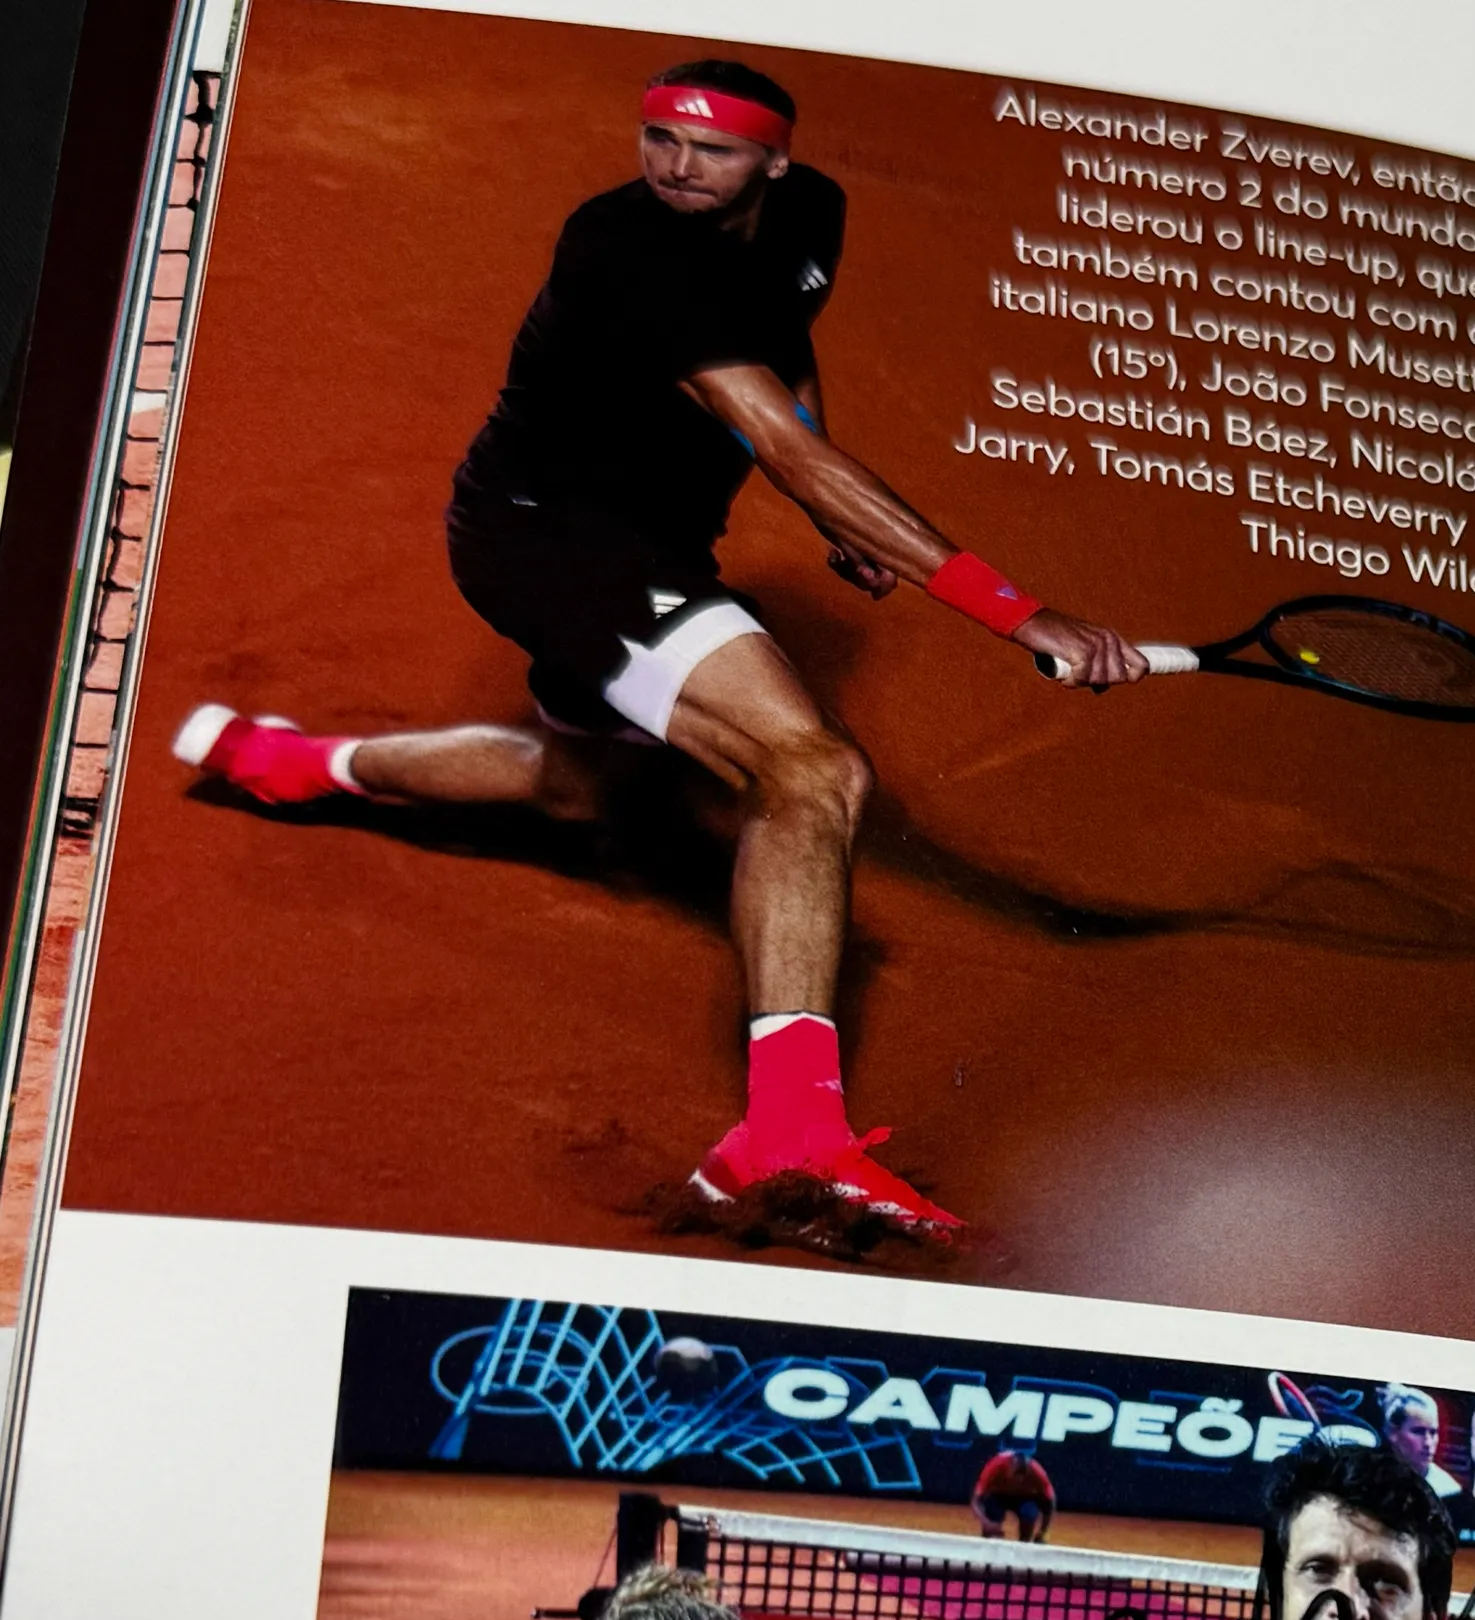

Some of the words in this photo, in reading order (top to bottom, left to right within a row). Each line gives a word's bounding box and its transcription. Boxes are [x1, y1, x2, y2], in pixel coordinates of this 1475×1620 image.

[995, 94, 1208, 153] Alexander
[1221, 128, 1361, 186] Zverev,
[1064, 153, 1227, 201] número
[1239, 180, 1262, 207] 2
[1274, 185, 1328, 219] do
[1059, 194, 1203, 245] liderou
[1216, 225, 1243, 250] o
[1256, 219, 1405, 287] line-up,
[992, 279, 1153, 331] italiano
[1167, 303, 1334, 363] Lorenzo
[1014, 235, 1198, 290] também
[1212, 273, 1356, 321] contou
[1369, 305, 1457, 342] com
[993, 380, 1209, 441] Sebastián
[1225, 412, 1337, 468] Báez,
[1202, 360, 1306, 406] João
[955, 424, 1075, 475] Jarry,
[1090, 442, 1234, 496] Tomás
[1248, 468, 1466, 548] Etcheverry
[1241, 517, 1389, 578] Thiago
